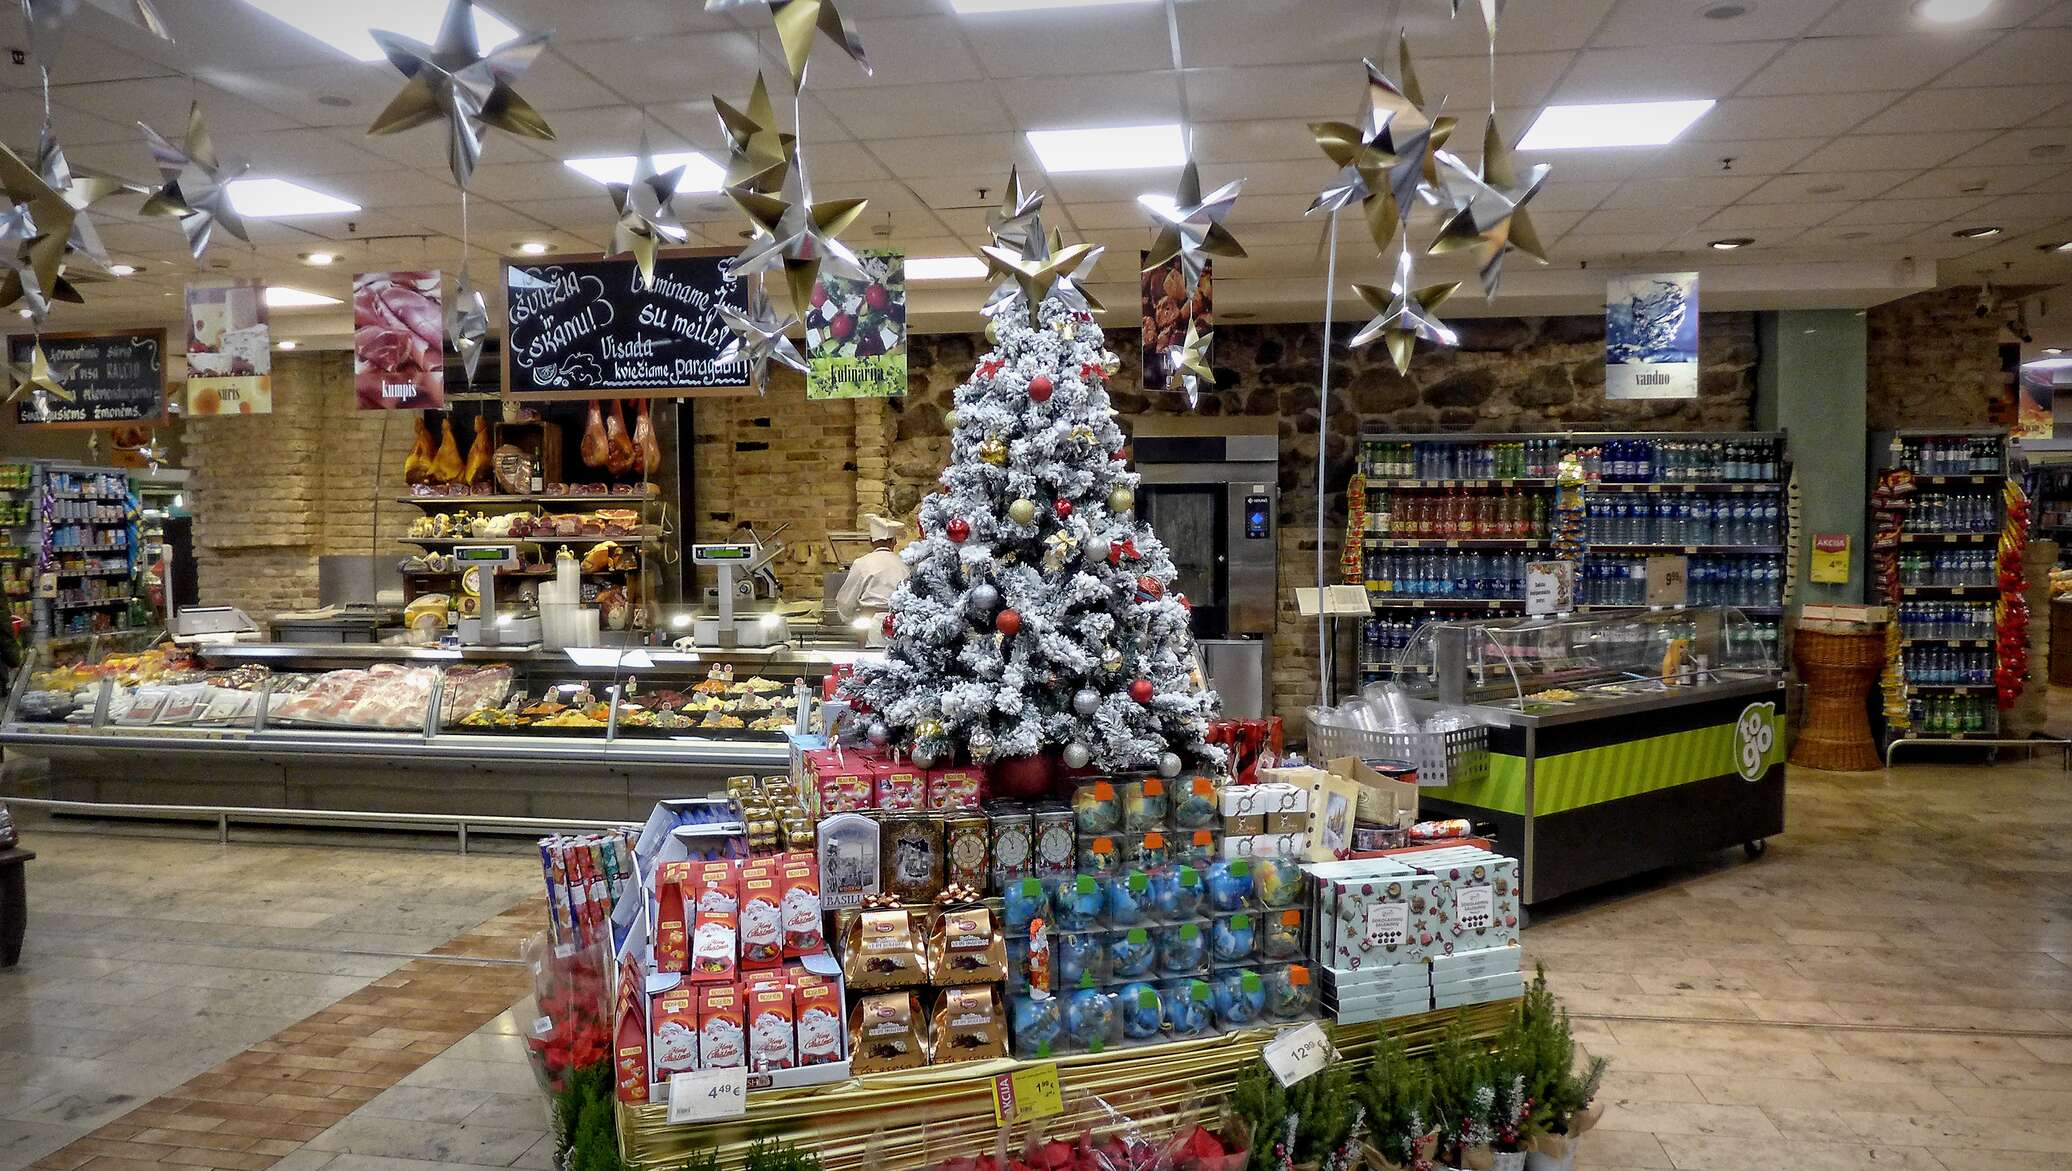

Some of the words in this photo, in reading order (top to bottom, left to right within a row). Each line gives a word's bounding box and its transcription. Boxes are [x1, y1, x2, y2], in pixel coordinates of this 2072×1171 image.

[630, 263, 710, 312] Gminame
[540, 314, 554, 330] ir
[601, 331, 654, 360] Visada
[614, 359, 670, 380] kviečiame
[831, 364, 885, 385] kulinarija
[1635, 370, 1670, 386] vanduo
[382, 379, 417, 401] kumpis
